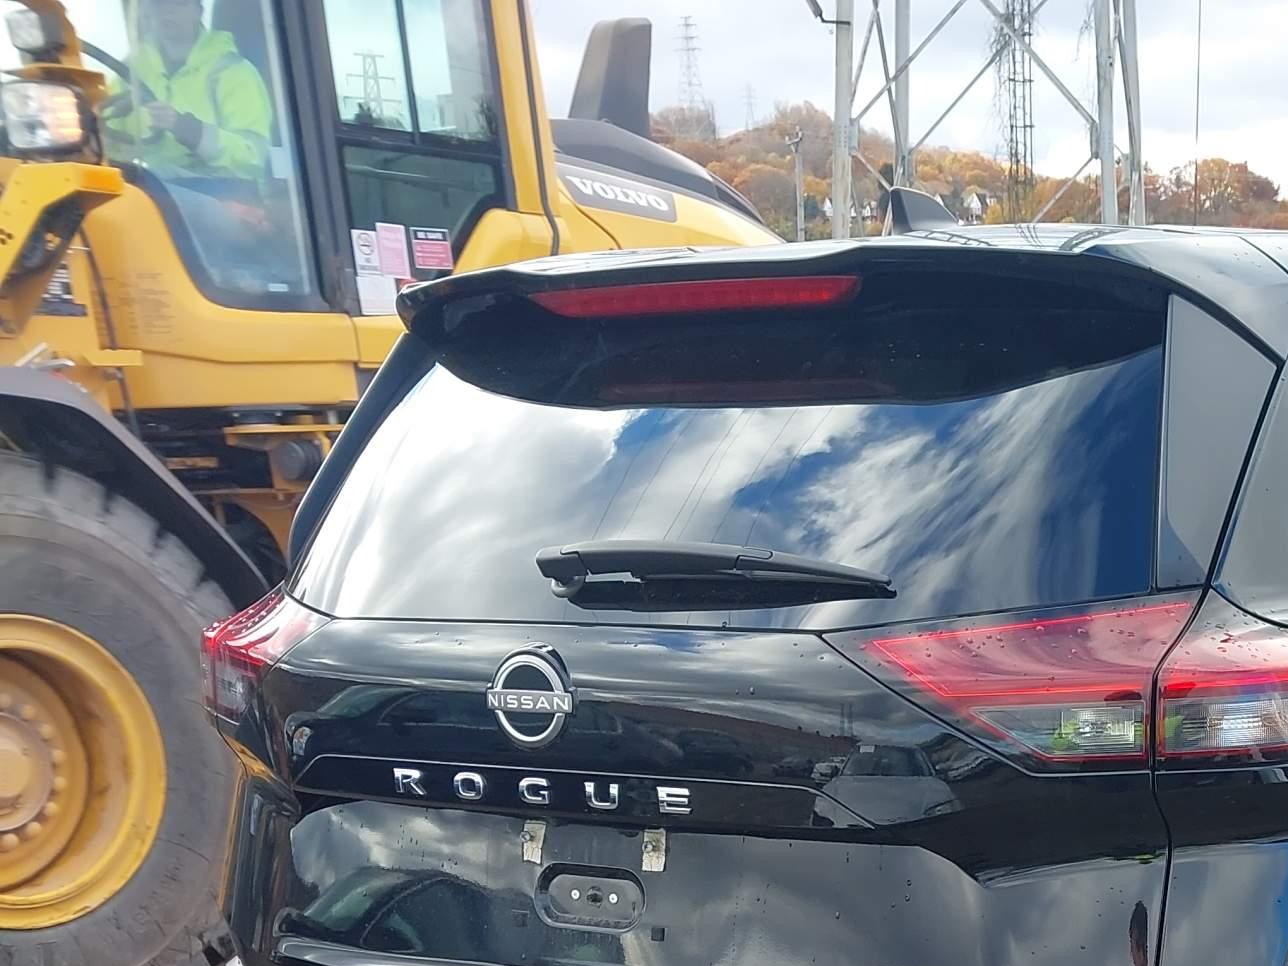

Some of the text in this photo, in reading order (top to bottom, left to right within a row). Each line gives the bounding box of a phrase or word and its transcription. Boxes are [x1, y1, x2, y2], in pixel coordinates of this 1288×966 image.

[565, 175, 669, 211] VOLVO
[488, 693, 569, 710] NISSAN
[393, 768, 693, 814] ROGUE
